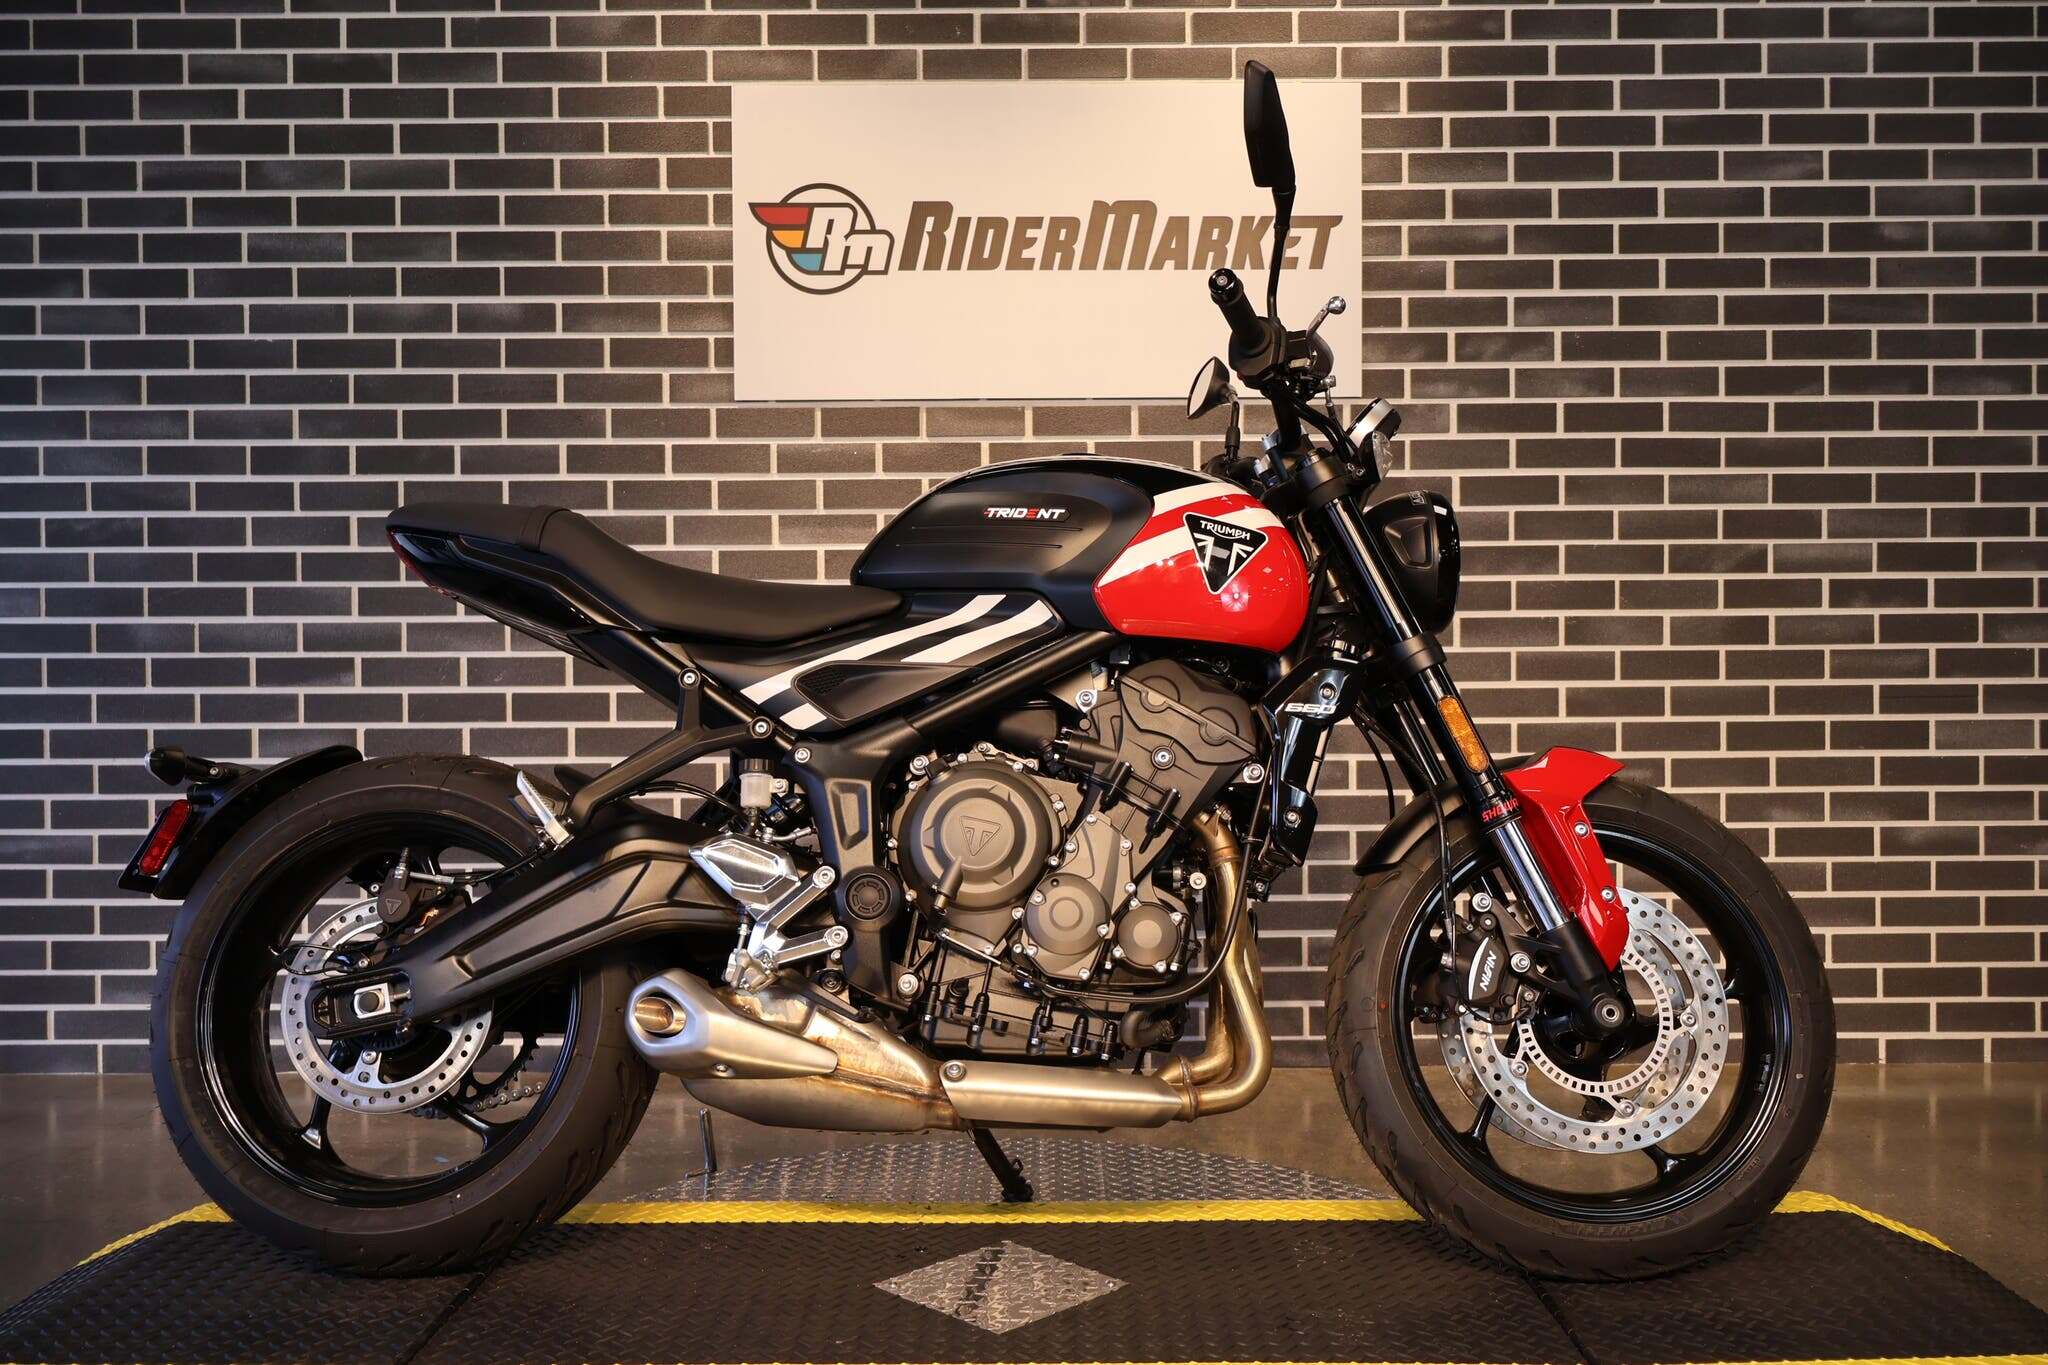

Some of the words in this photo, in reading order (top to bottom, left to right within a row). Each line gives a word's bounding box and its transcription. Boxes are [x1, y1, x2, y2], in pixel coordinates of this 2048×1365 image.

[986, 507, 1066, 519] TRIDENT
[1200, 520, 1251, 540] TRIUMPH
[1284, 702, 1337, 714] 660
